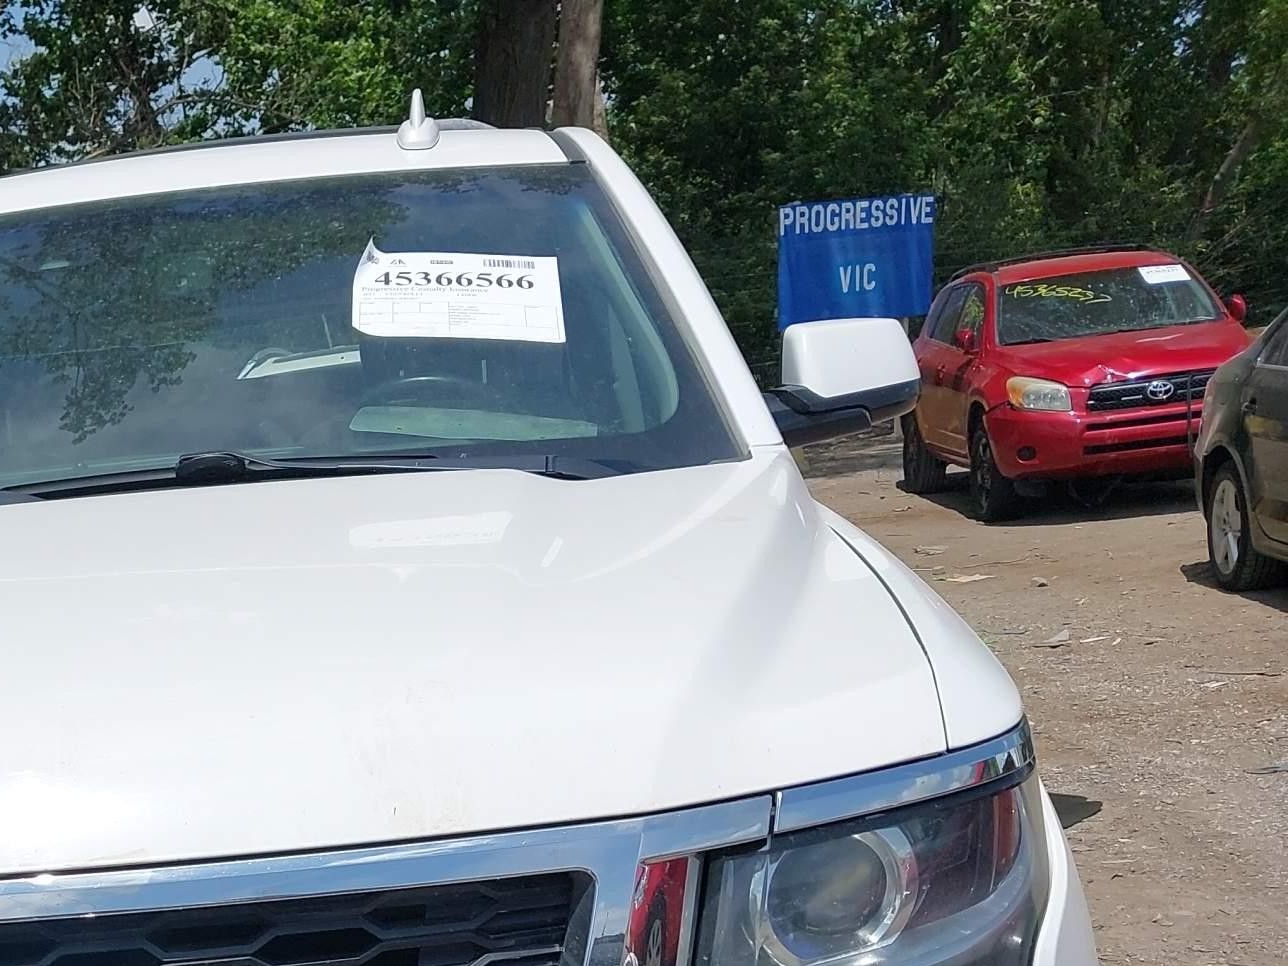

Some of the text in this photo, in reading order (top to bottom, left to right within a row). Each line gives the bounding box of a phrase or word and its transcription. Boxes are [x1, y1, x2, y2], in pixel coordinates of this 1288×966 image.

[779, 196, 934, 236] PROGRESSIVE
[374, 271, 535, 290] 45366566
[839, 263, 876, 294] VIC
